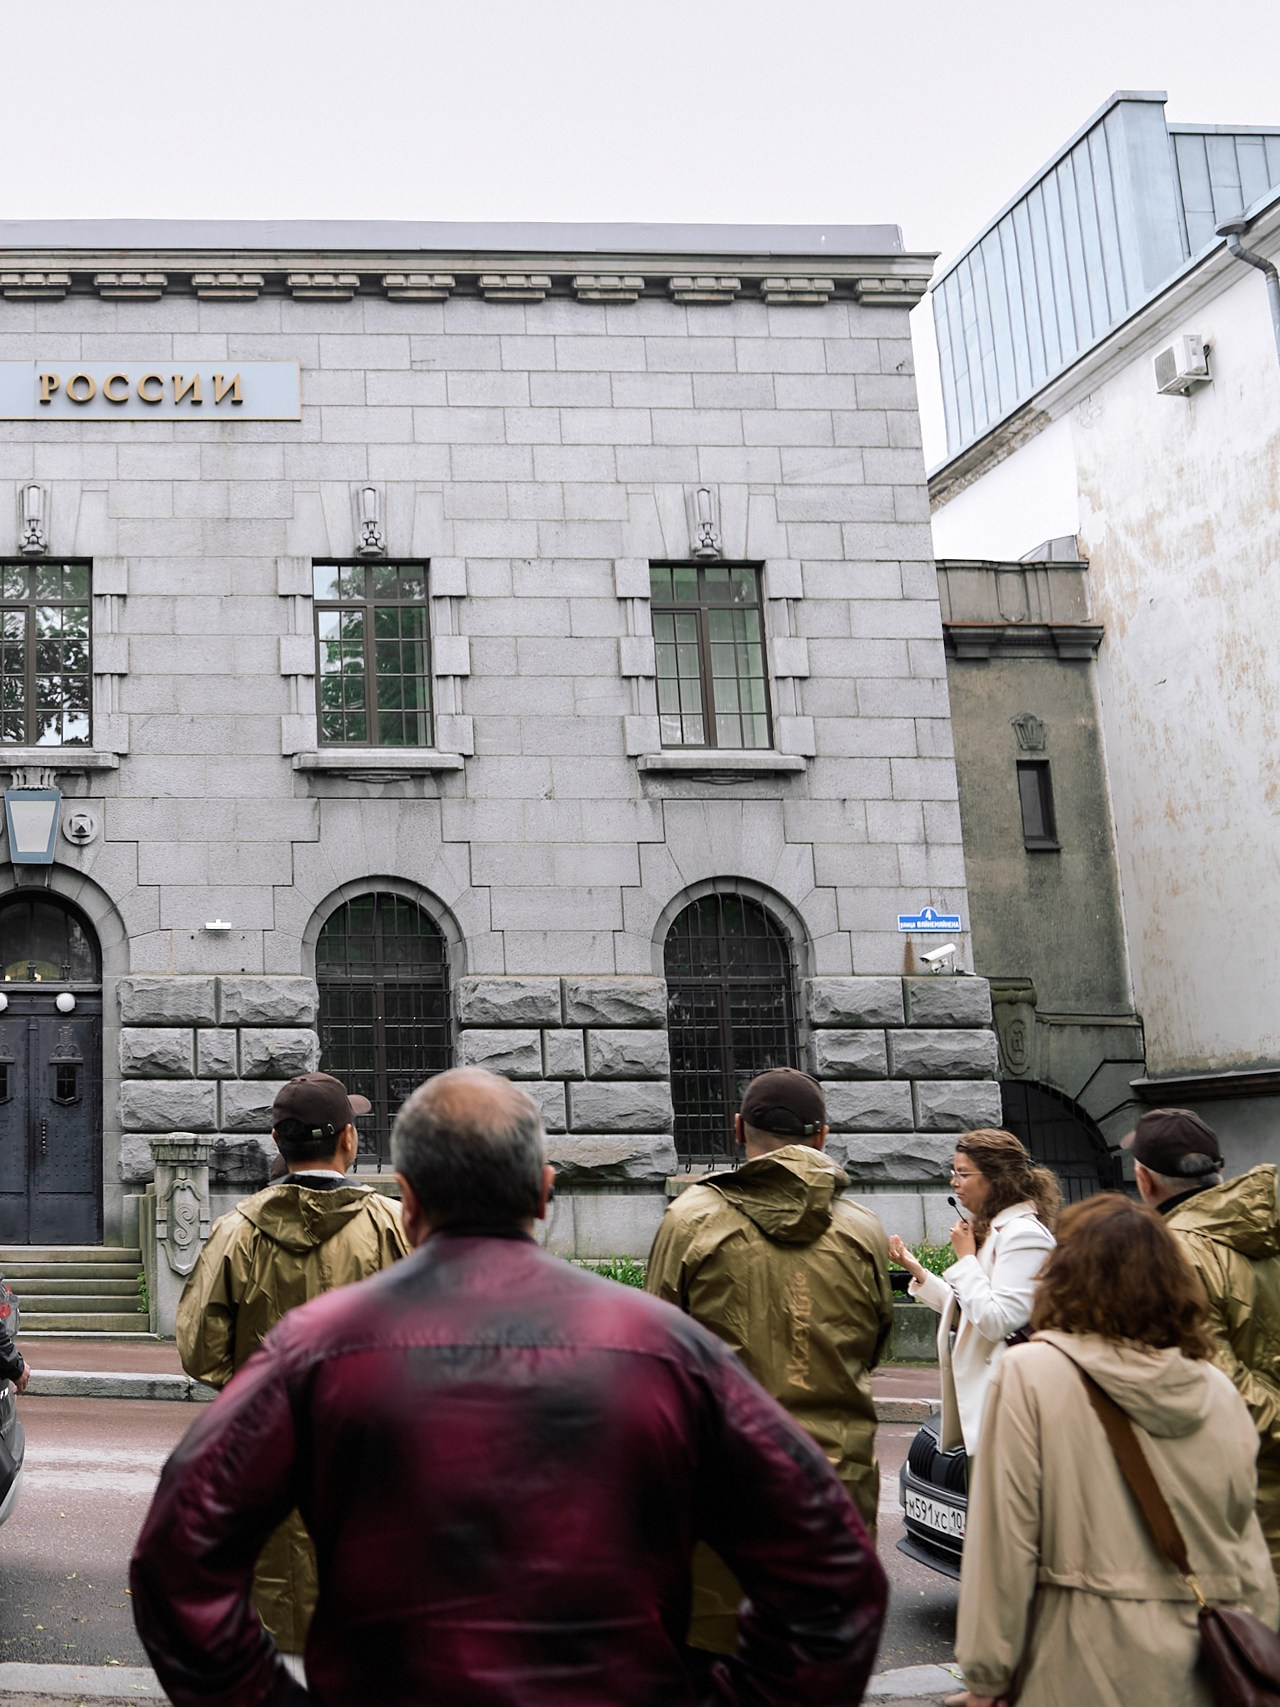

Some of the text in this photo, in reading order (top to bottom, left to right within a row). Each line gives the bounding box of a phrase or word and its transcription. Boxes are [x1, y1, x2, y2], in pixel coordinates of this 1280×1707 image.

[39, 372, 244, 406] РОССИИ
[925, 909, 932, 921] 4
[951, 1511, 966, 1529] 10
